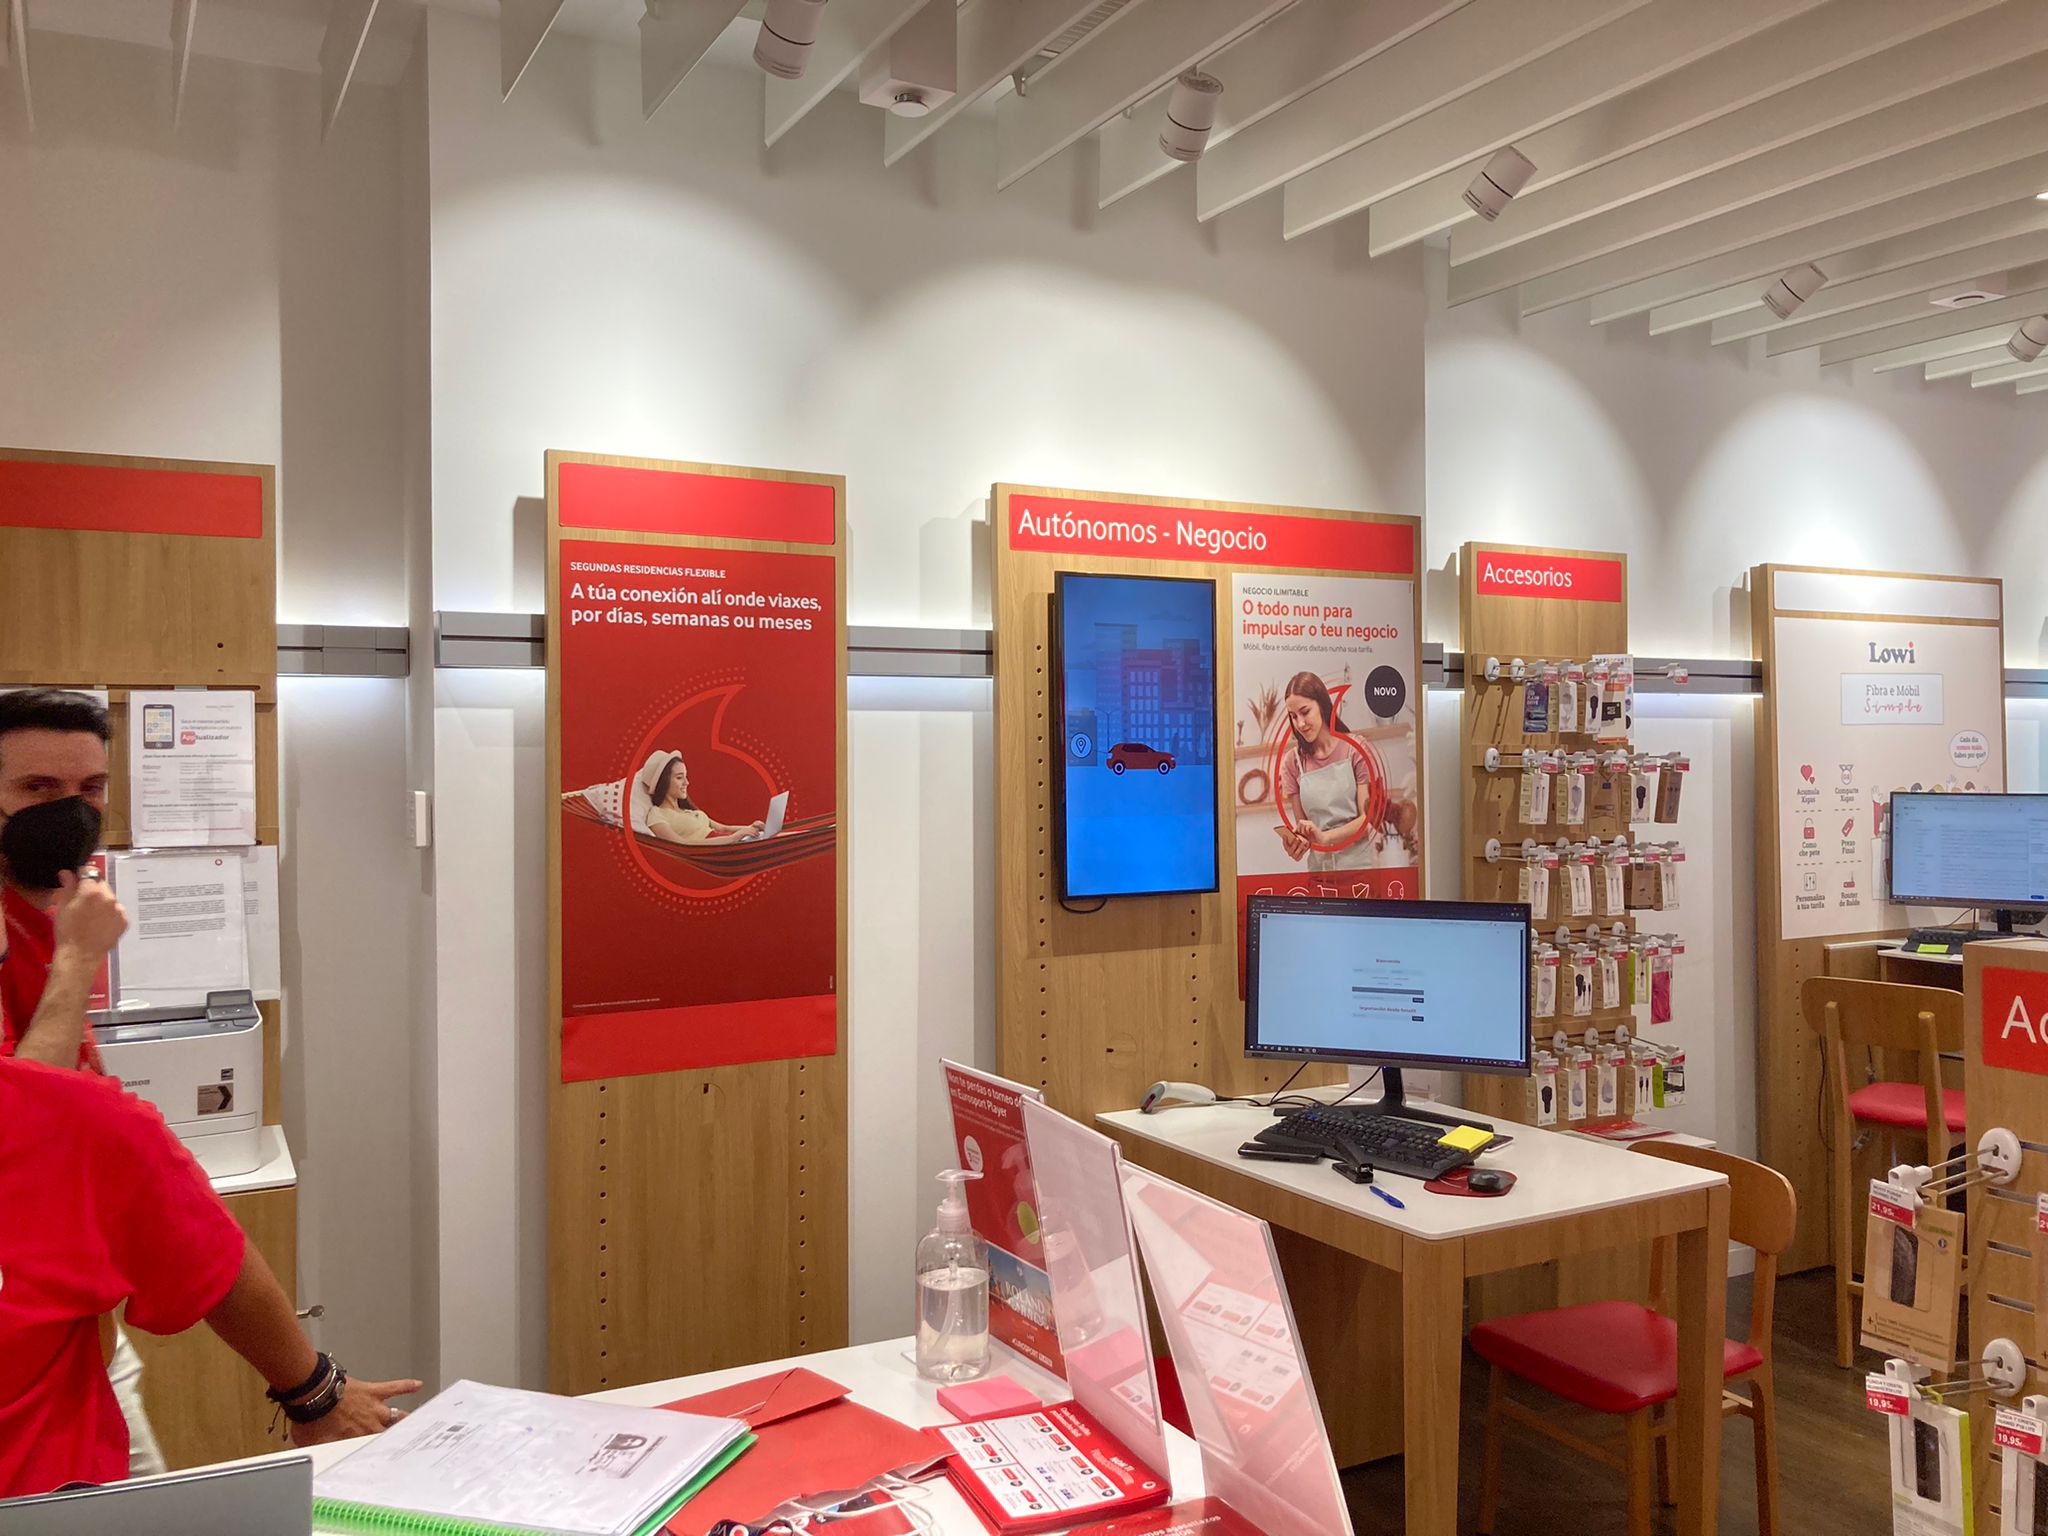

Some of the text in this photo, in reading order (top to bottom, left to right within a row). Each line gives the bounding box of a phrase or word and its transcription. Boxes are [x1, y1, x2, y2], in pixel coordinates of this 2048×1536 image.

[1017, 508, 1157, 544] Autónomos
[1177, 521, 1267, 554] Negocio
[571, 561, 726, 579] SEGUNDAS RESIDENCIAS FLEXIBLE
[1483, 562, 1573, 588] Accesorios
[571, 582, 822, 612] A túa conexión alí onde viaxes,
[1243, 587, 1309, 598] NEGOCIO ILIMITABLE
[572, 608, 812, 631] por días, semanas ou meses
[1242, 600, 1352, 620] O todo nun para
[1243, 620, 1398, 642] impulsar o teu negocio
[1868, 641, 1916, 664] Lowi
[1374, 687, 1397, 697] NOVO
[1866, 684, 1920, 697] Fibra e Móbil
